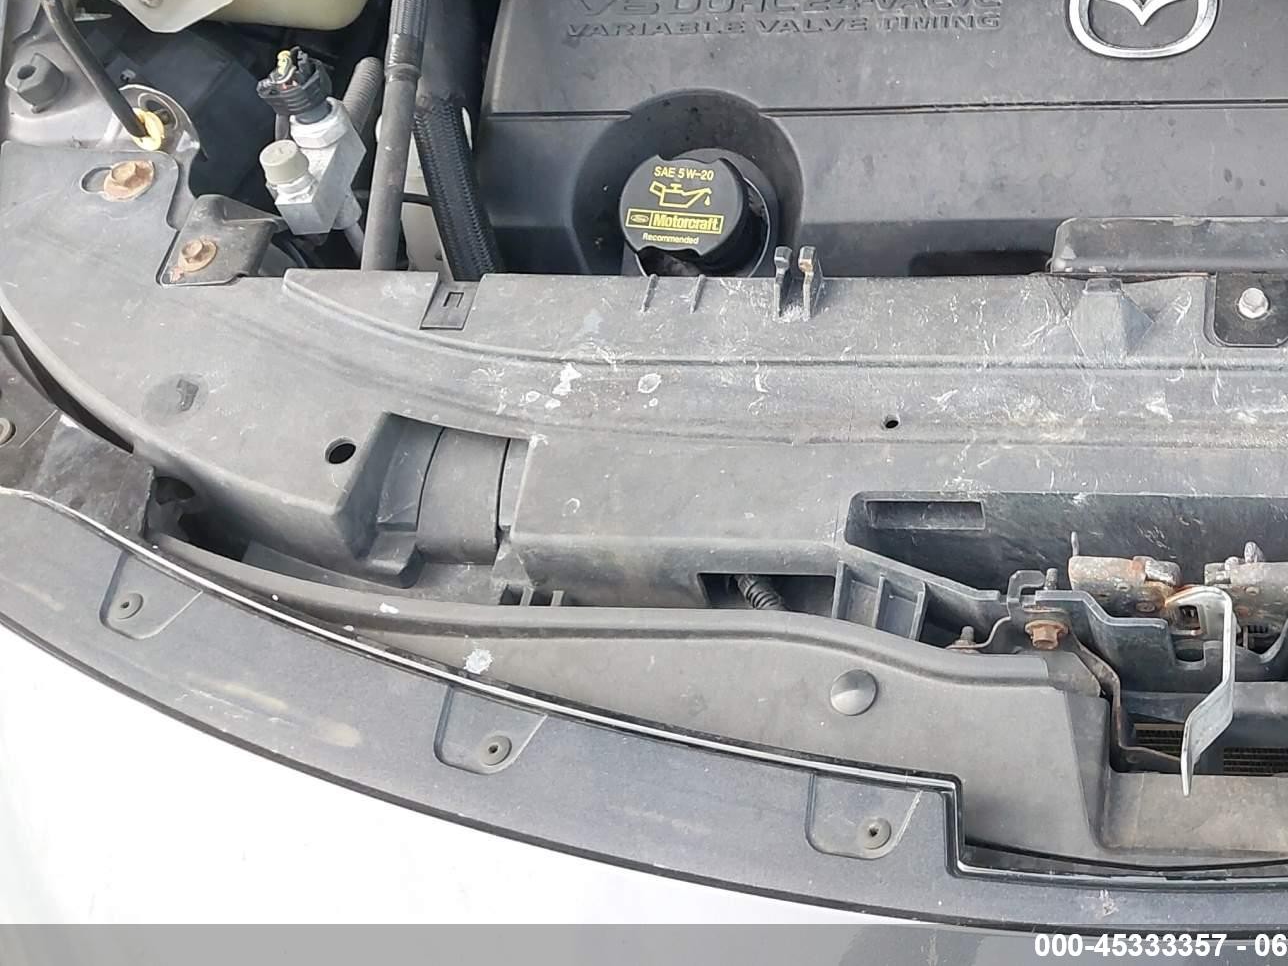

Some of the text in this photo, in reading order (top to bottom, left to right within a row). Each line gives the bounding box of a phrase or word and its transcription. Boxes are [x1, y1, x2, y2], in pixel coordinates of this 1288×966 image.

[567, 11, 1002, 36] VARIABLE VALVE TIMING
[654, 166, 714, 181] SAE 5W-20
[652, 213, 719, 231] Motorcraft
[643, 232, 699, 244] Recommended
